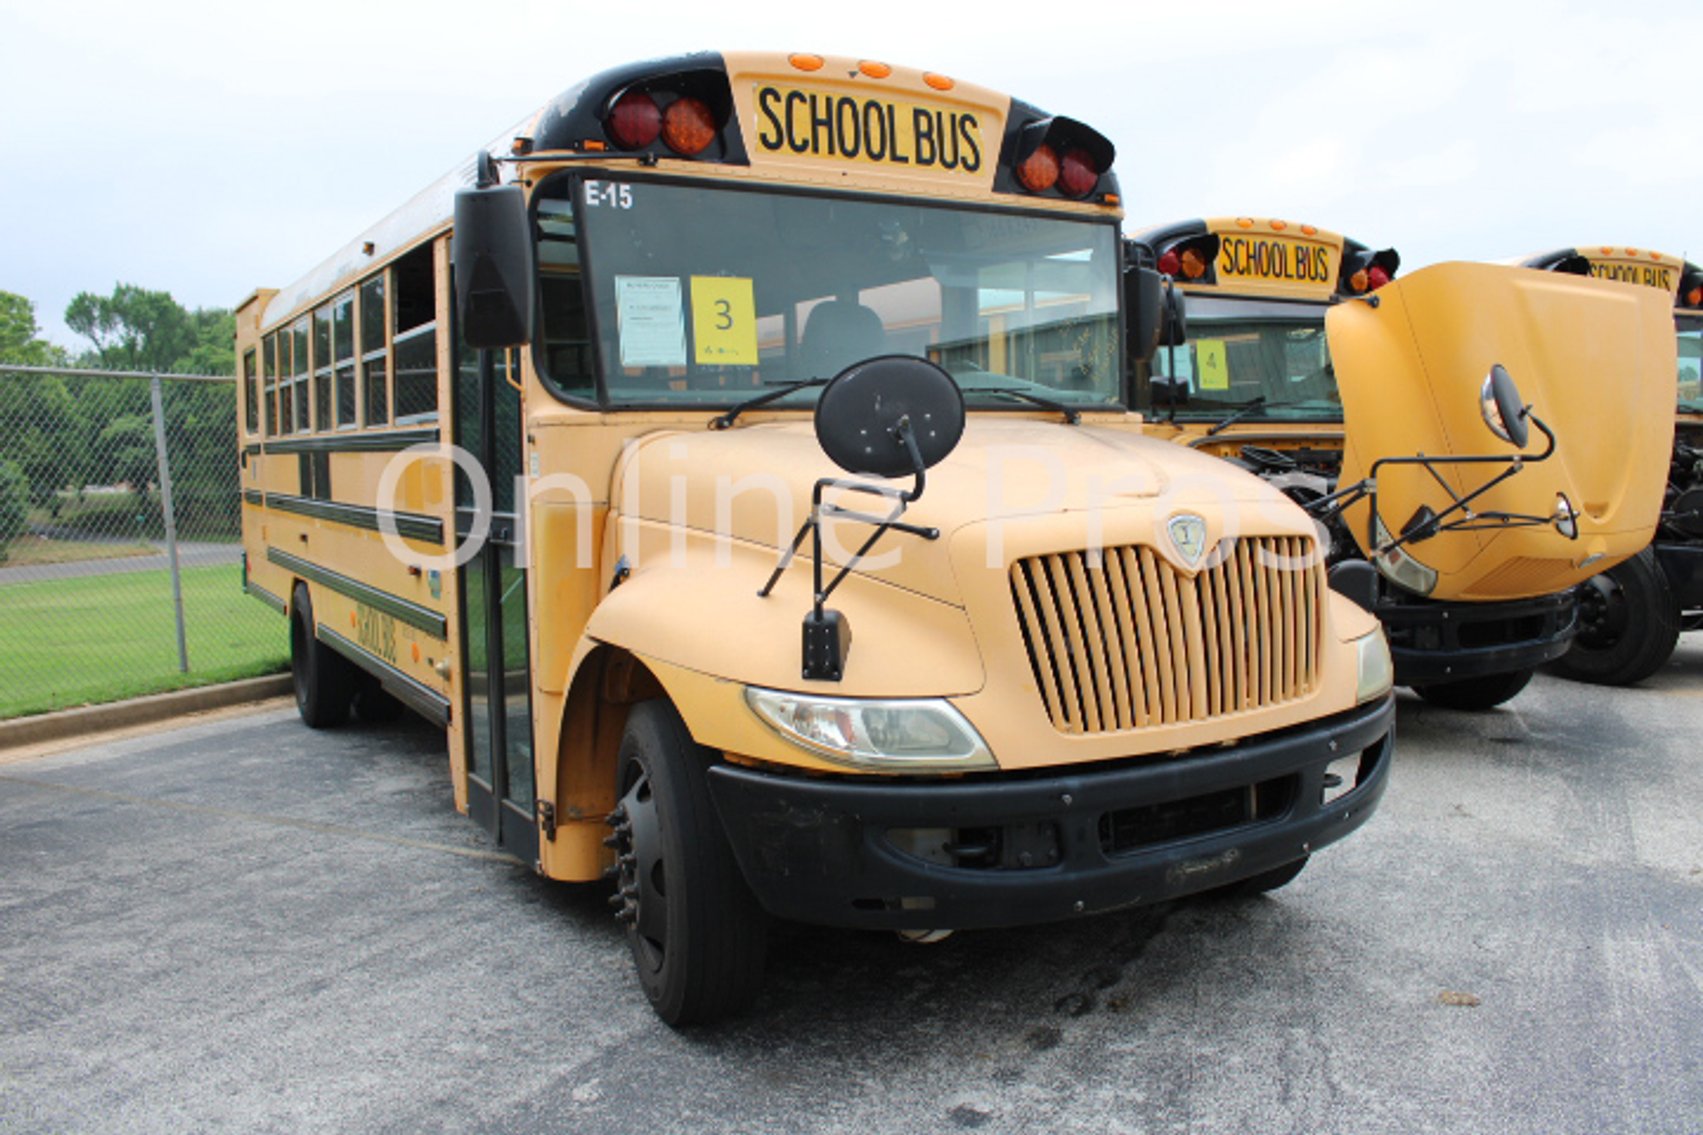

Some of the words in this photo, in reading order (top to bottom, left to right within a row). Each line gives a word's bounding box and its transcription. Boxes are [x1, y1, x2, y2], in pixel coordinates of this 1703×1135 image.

[759, 87, 909, 164] SCHOOL
[913, 107, 981, 172] BUS
[584, 179, 632, 209] E-15
[1222, 237, 1294, 278] SCHOOL
[1295, 245, 1329, 282] BUS
[713, 299, 734, 330] 3
